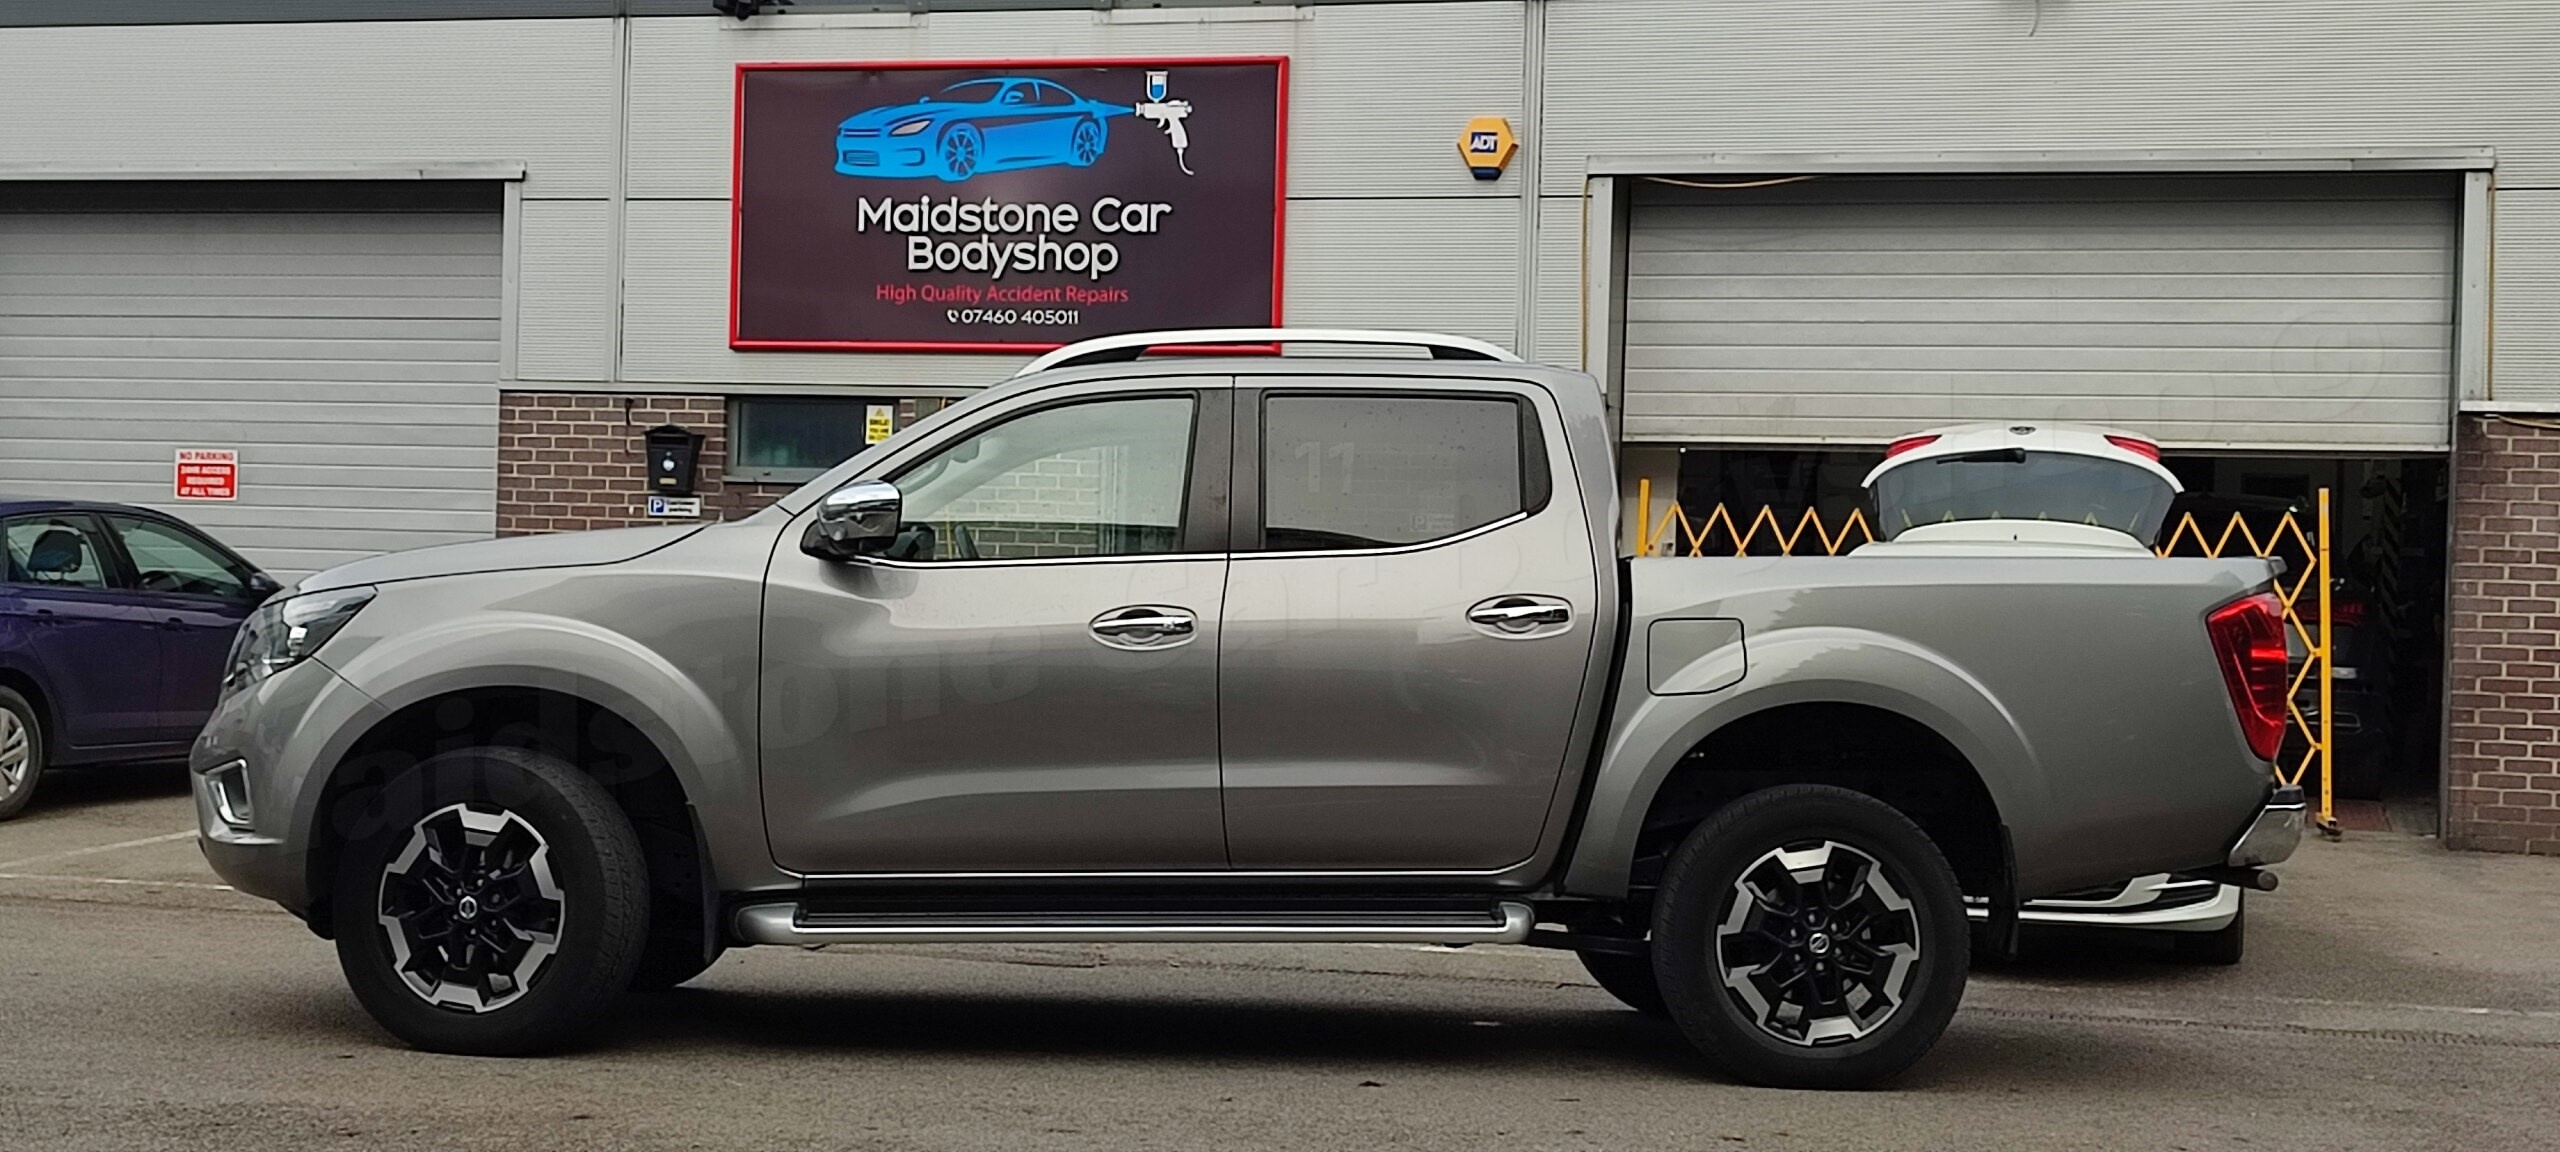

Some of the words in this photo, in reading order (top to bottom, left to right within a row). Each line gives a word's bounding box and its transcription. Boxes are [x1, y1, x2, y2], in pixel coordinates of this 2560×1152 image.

[1471, 134, 1498, 150] ADT
[857, 195, 1079, 232] Maidstone
[1092, 197, 1173, 233] Car
[907, 233, 1119, 280] Bodyshop
[876, 284, 917, 304] High
[921, 285, 981, 305] Quality
[986, 285, 1061, 302] Accident
[1065, 286, 1129, 305] Repairs
[960, 309, 1017, 324] 07460
[1020, 309, 1079, 325] 405011
[179, 451, 193, 461] NO
[195, 451, 234, 461] PARKING
[653, 499, 663, 512] P
